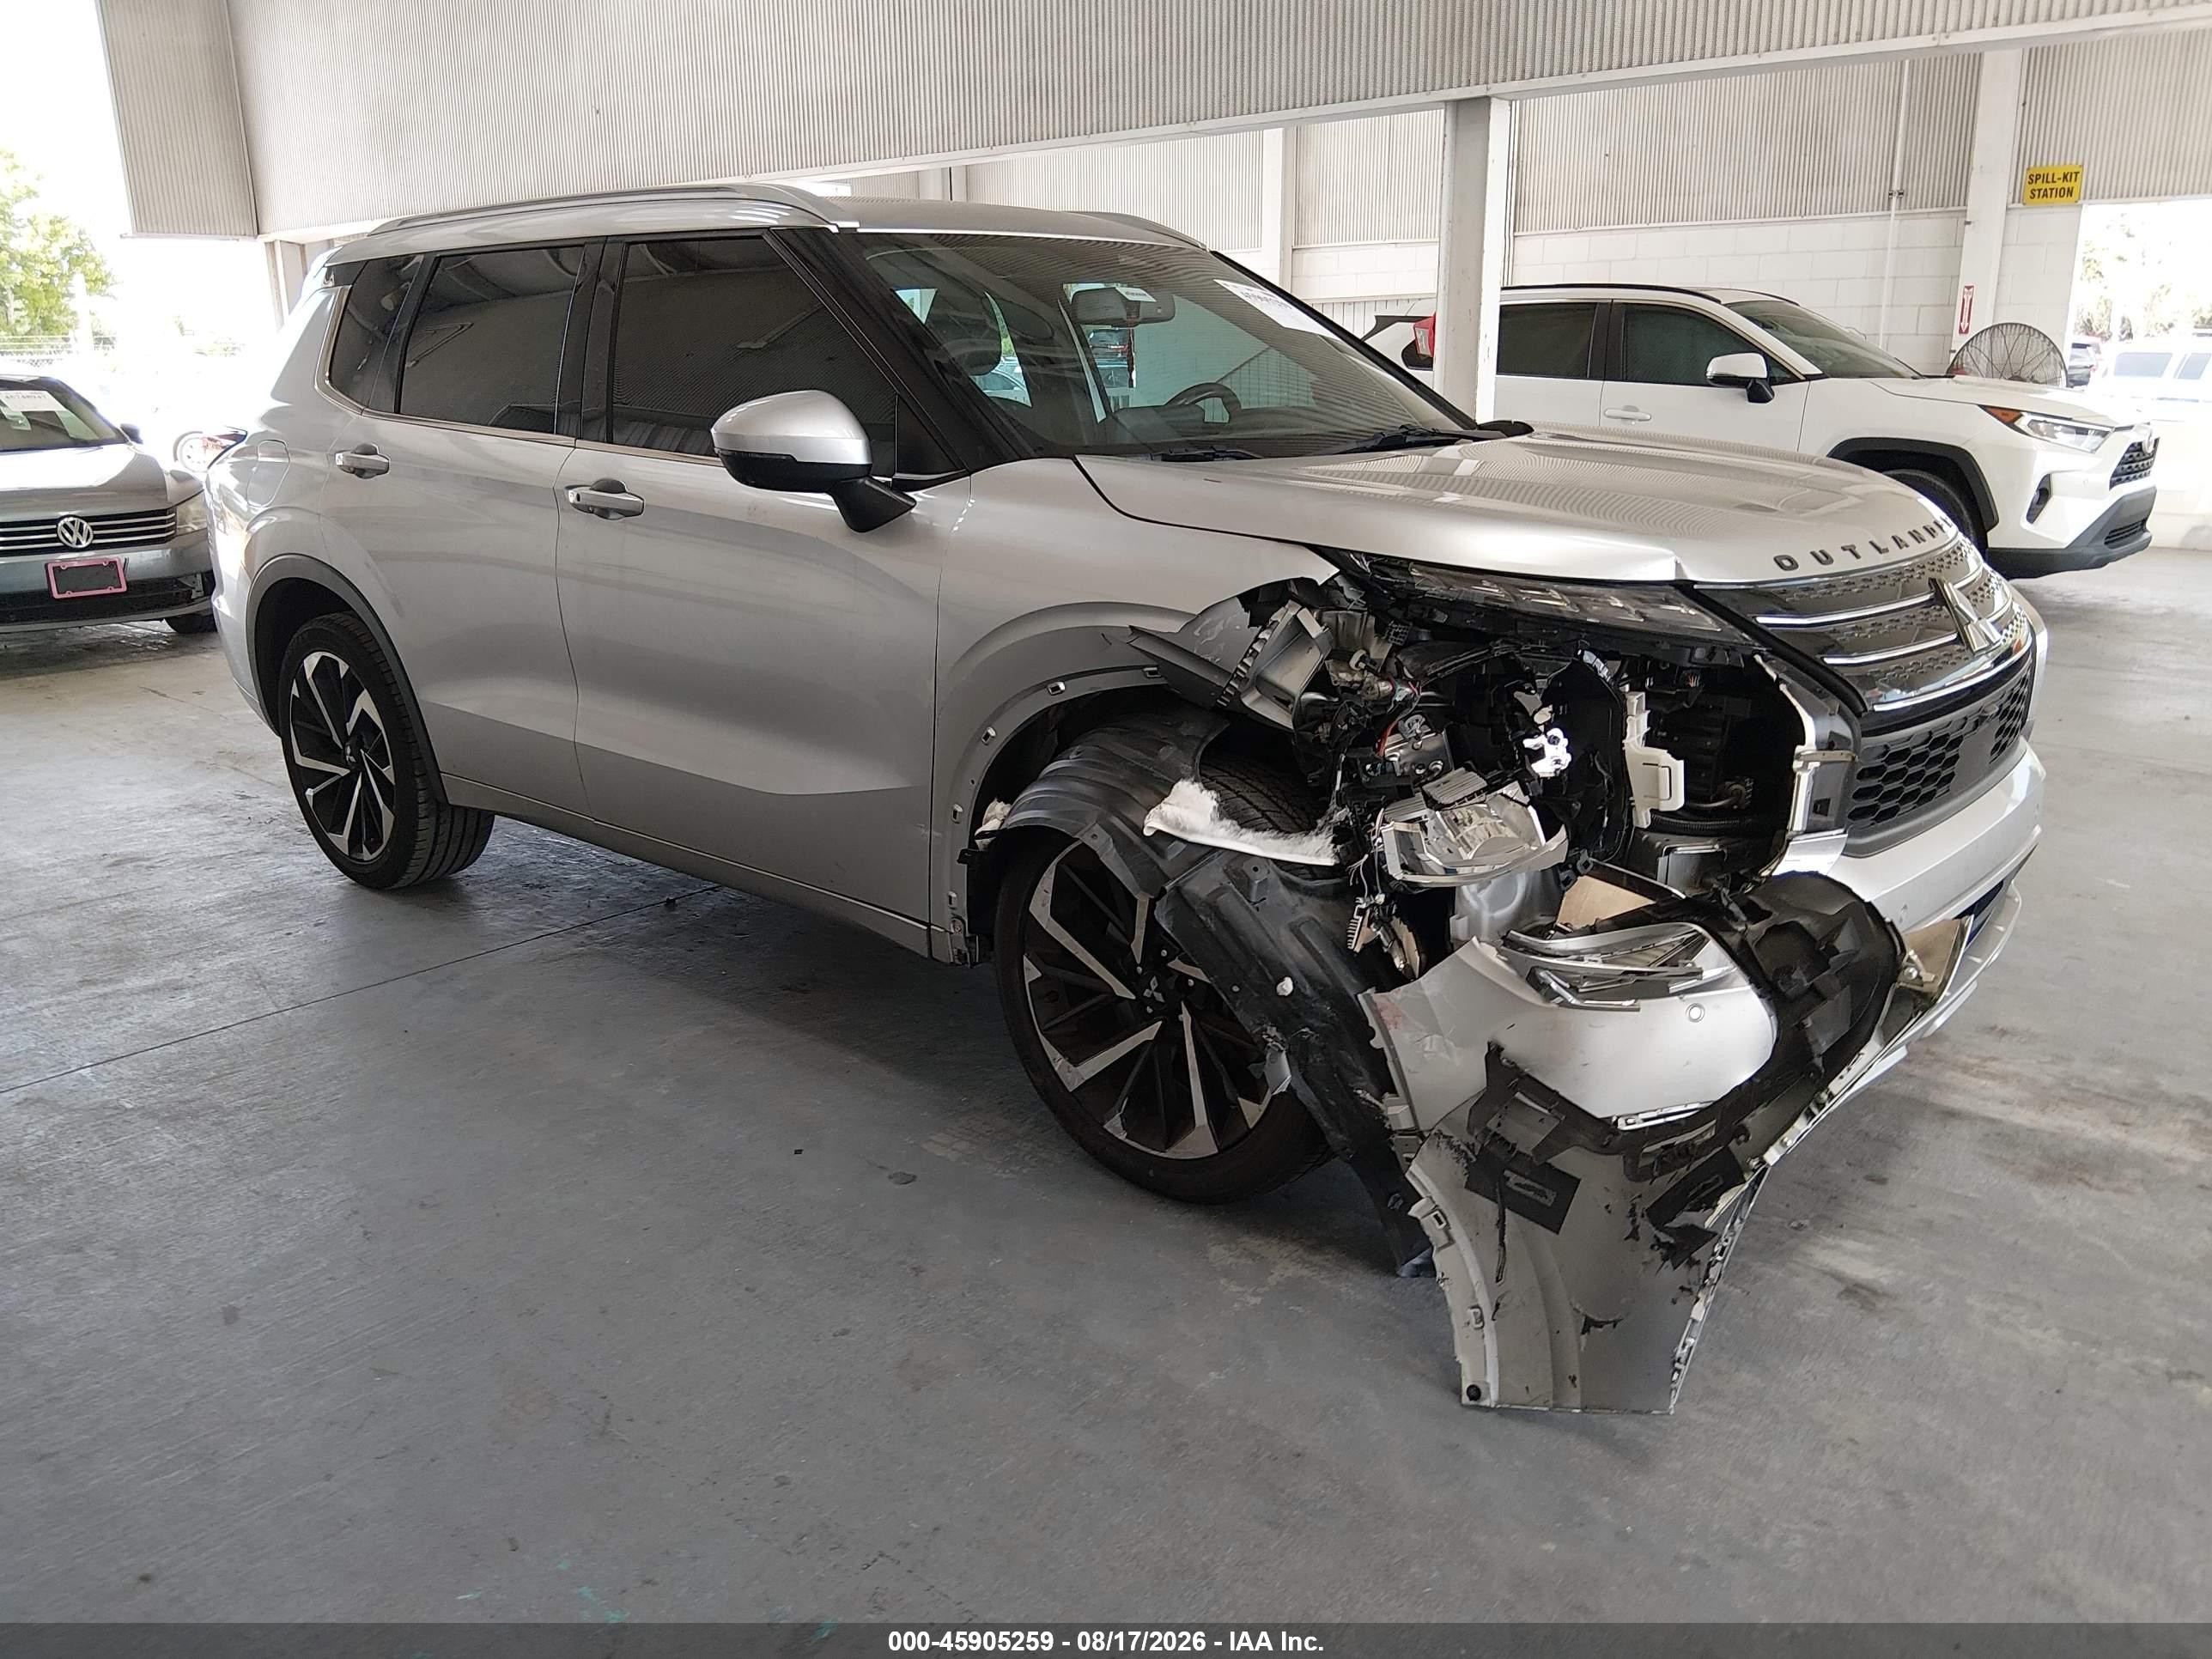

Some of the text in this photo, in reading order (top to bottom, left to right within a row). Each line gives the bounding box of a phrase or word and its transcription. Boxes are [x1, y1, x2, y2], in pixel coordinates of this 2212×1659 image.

[2027, 171, 2081, 185] SPILL-KIT
[2029, 186, 2075, 199] STATION
[58, 517, 94, 548] VW
